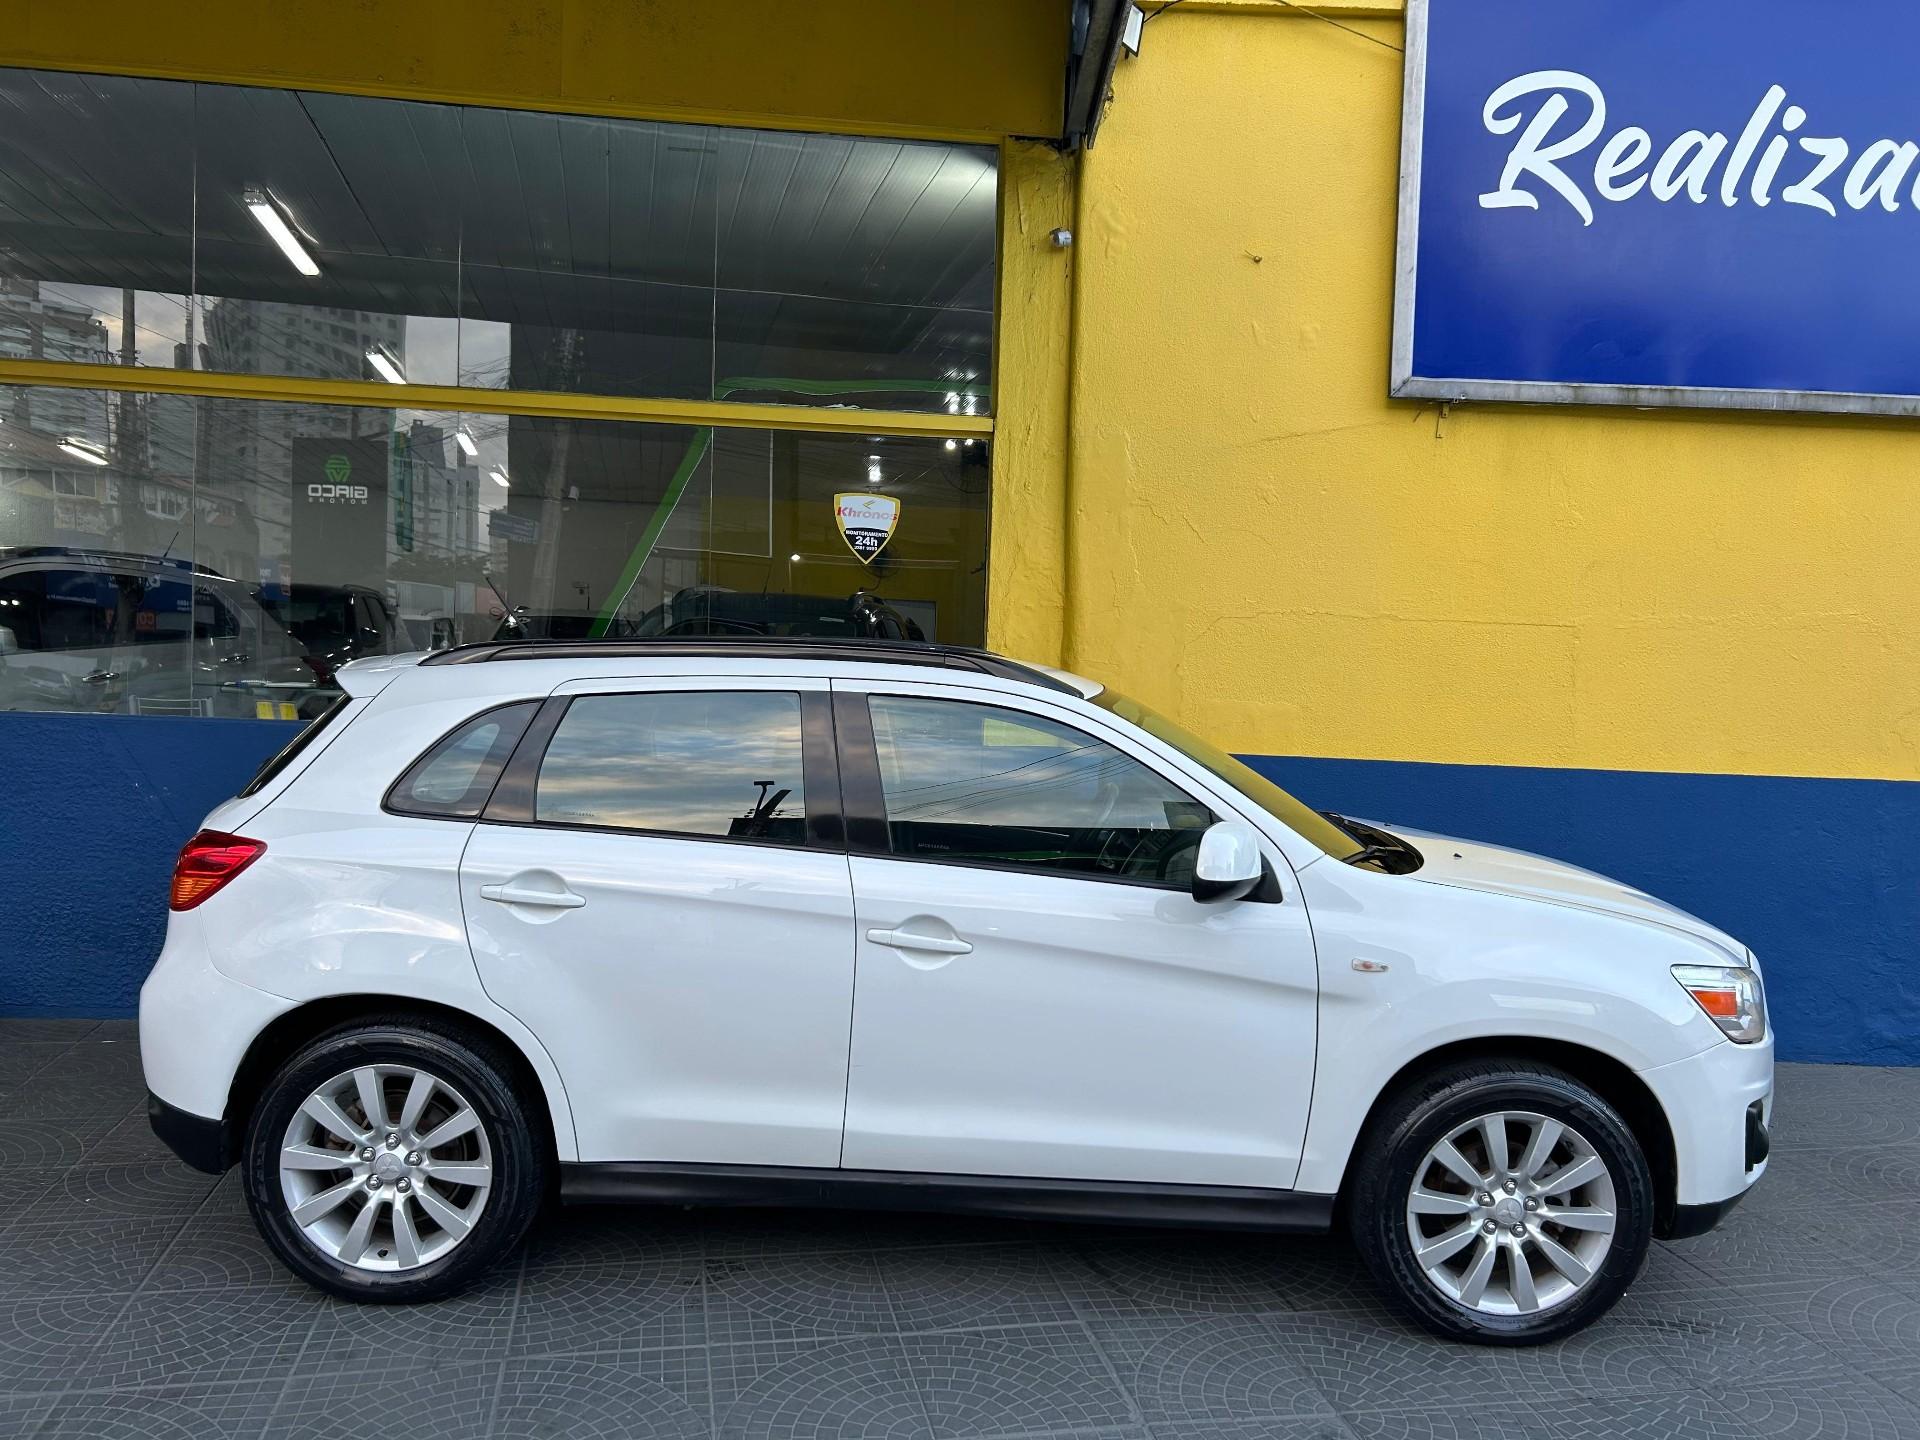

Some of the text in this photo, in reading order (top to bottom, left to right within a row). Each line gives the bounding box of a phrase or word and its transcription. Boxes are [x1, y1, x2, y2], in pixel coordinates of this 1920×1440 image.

[1479, 71, 1920, 226] Realiza
[837, 506, 898, 521] Khronos
[855, 536, 878, 547] 24h
